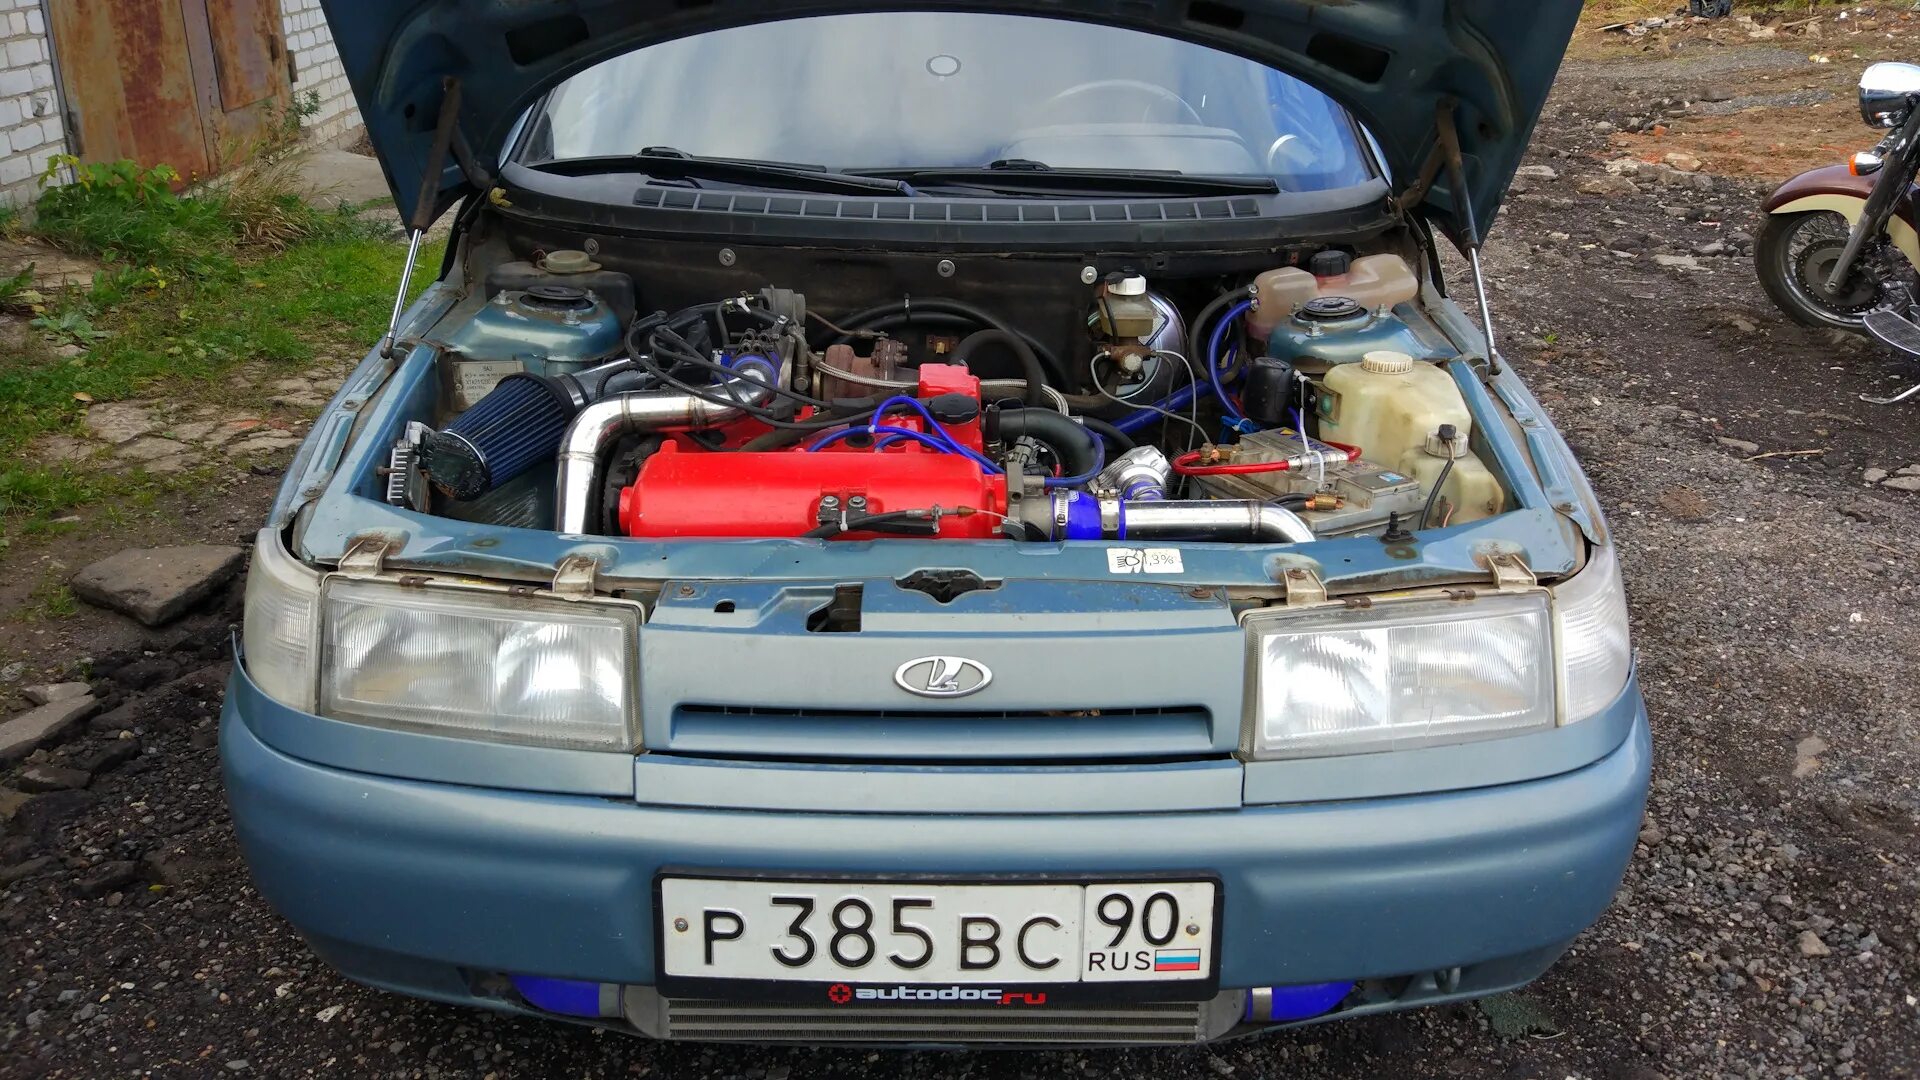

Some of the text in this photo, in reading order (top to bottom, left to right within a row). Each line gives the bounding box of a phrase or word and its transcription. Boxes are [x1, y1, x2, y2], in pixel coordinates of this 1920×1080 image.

[1096, 892, 1180, 949] 90
[1088, 950, 1152, 972] RUS
[855, 986, 1046, 1005] autodoc.ru
